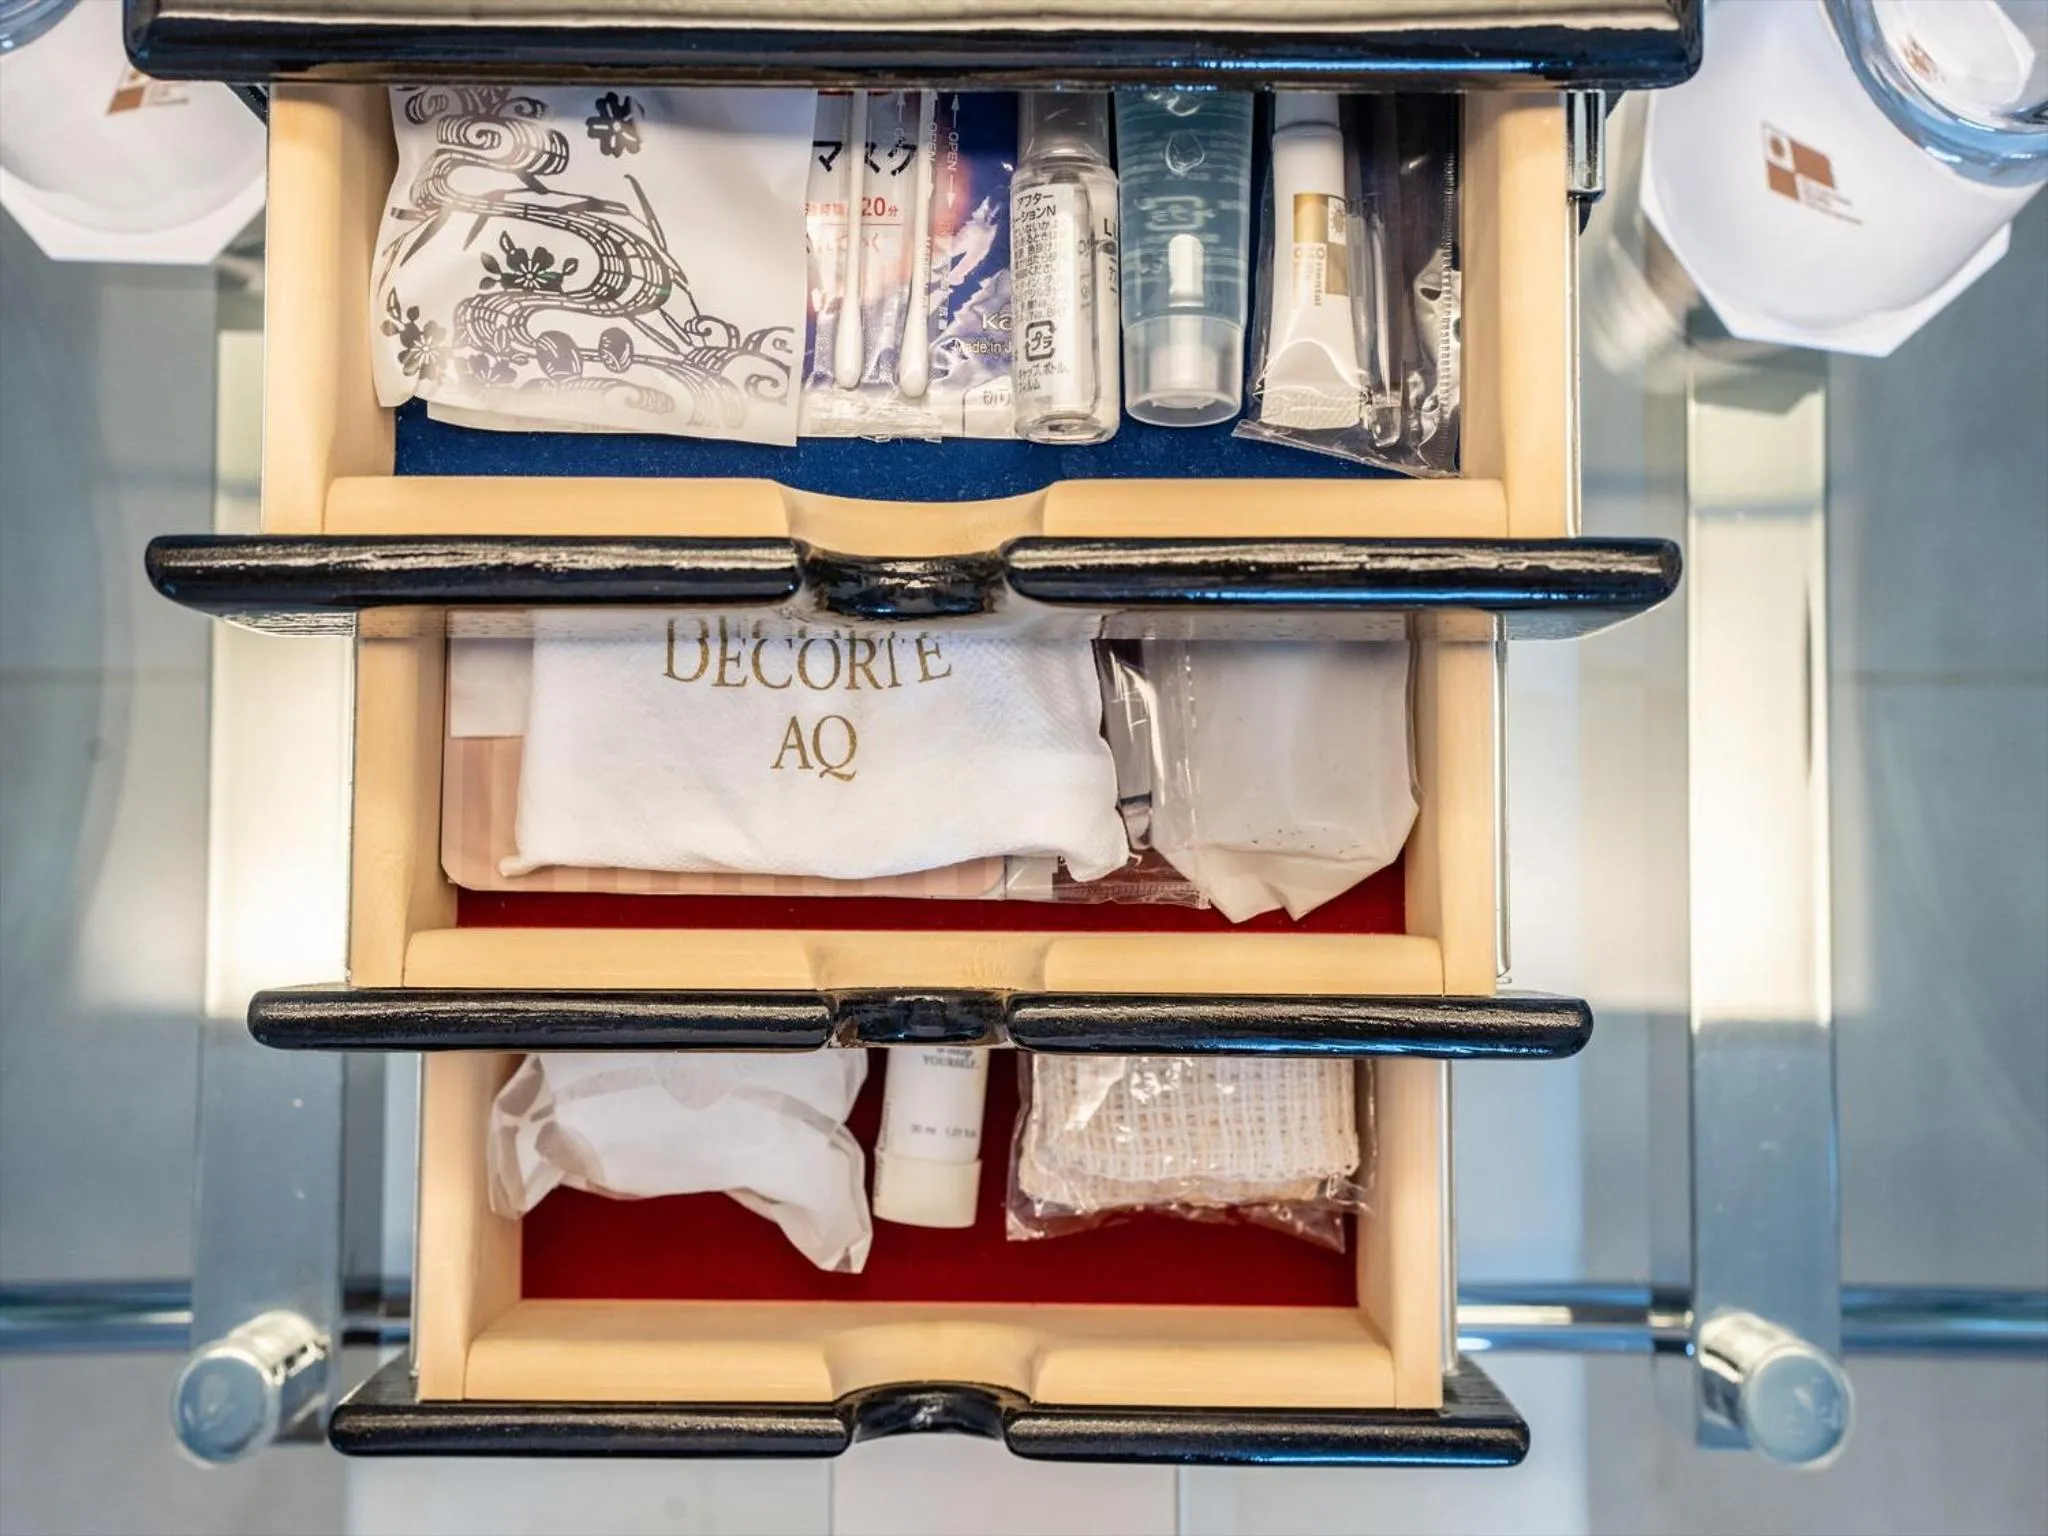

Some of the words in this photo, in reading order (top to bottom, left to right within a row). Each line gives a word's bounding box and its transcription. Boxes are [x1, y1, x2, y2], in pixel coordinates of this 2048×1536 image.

[948, 132, 960, 171] OPEN
[982, 313, 1012, 331] Ka
[991, 341, 1002, 353] in
[769, 714, 859, 783] AQ
